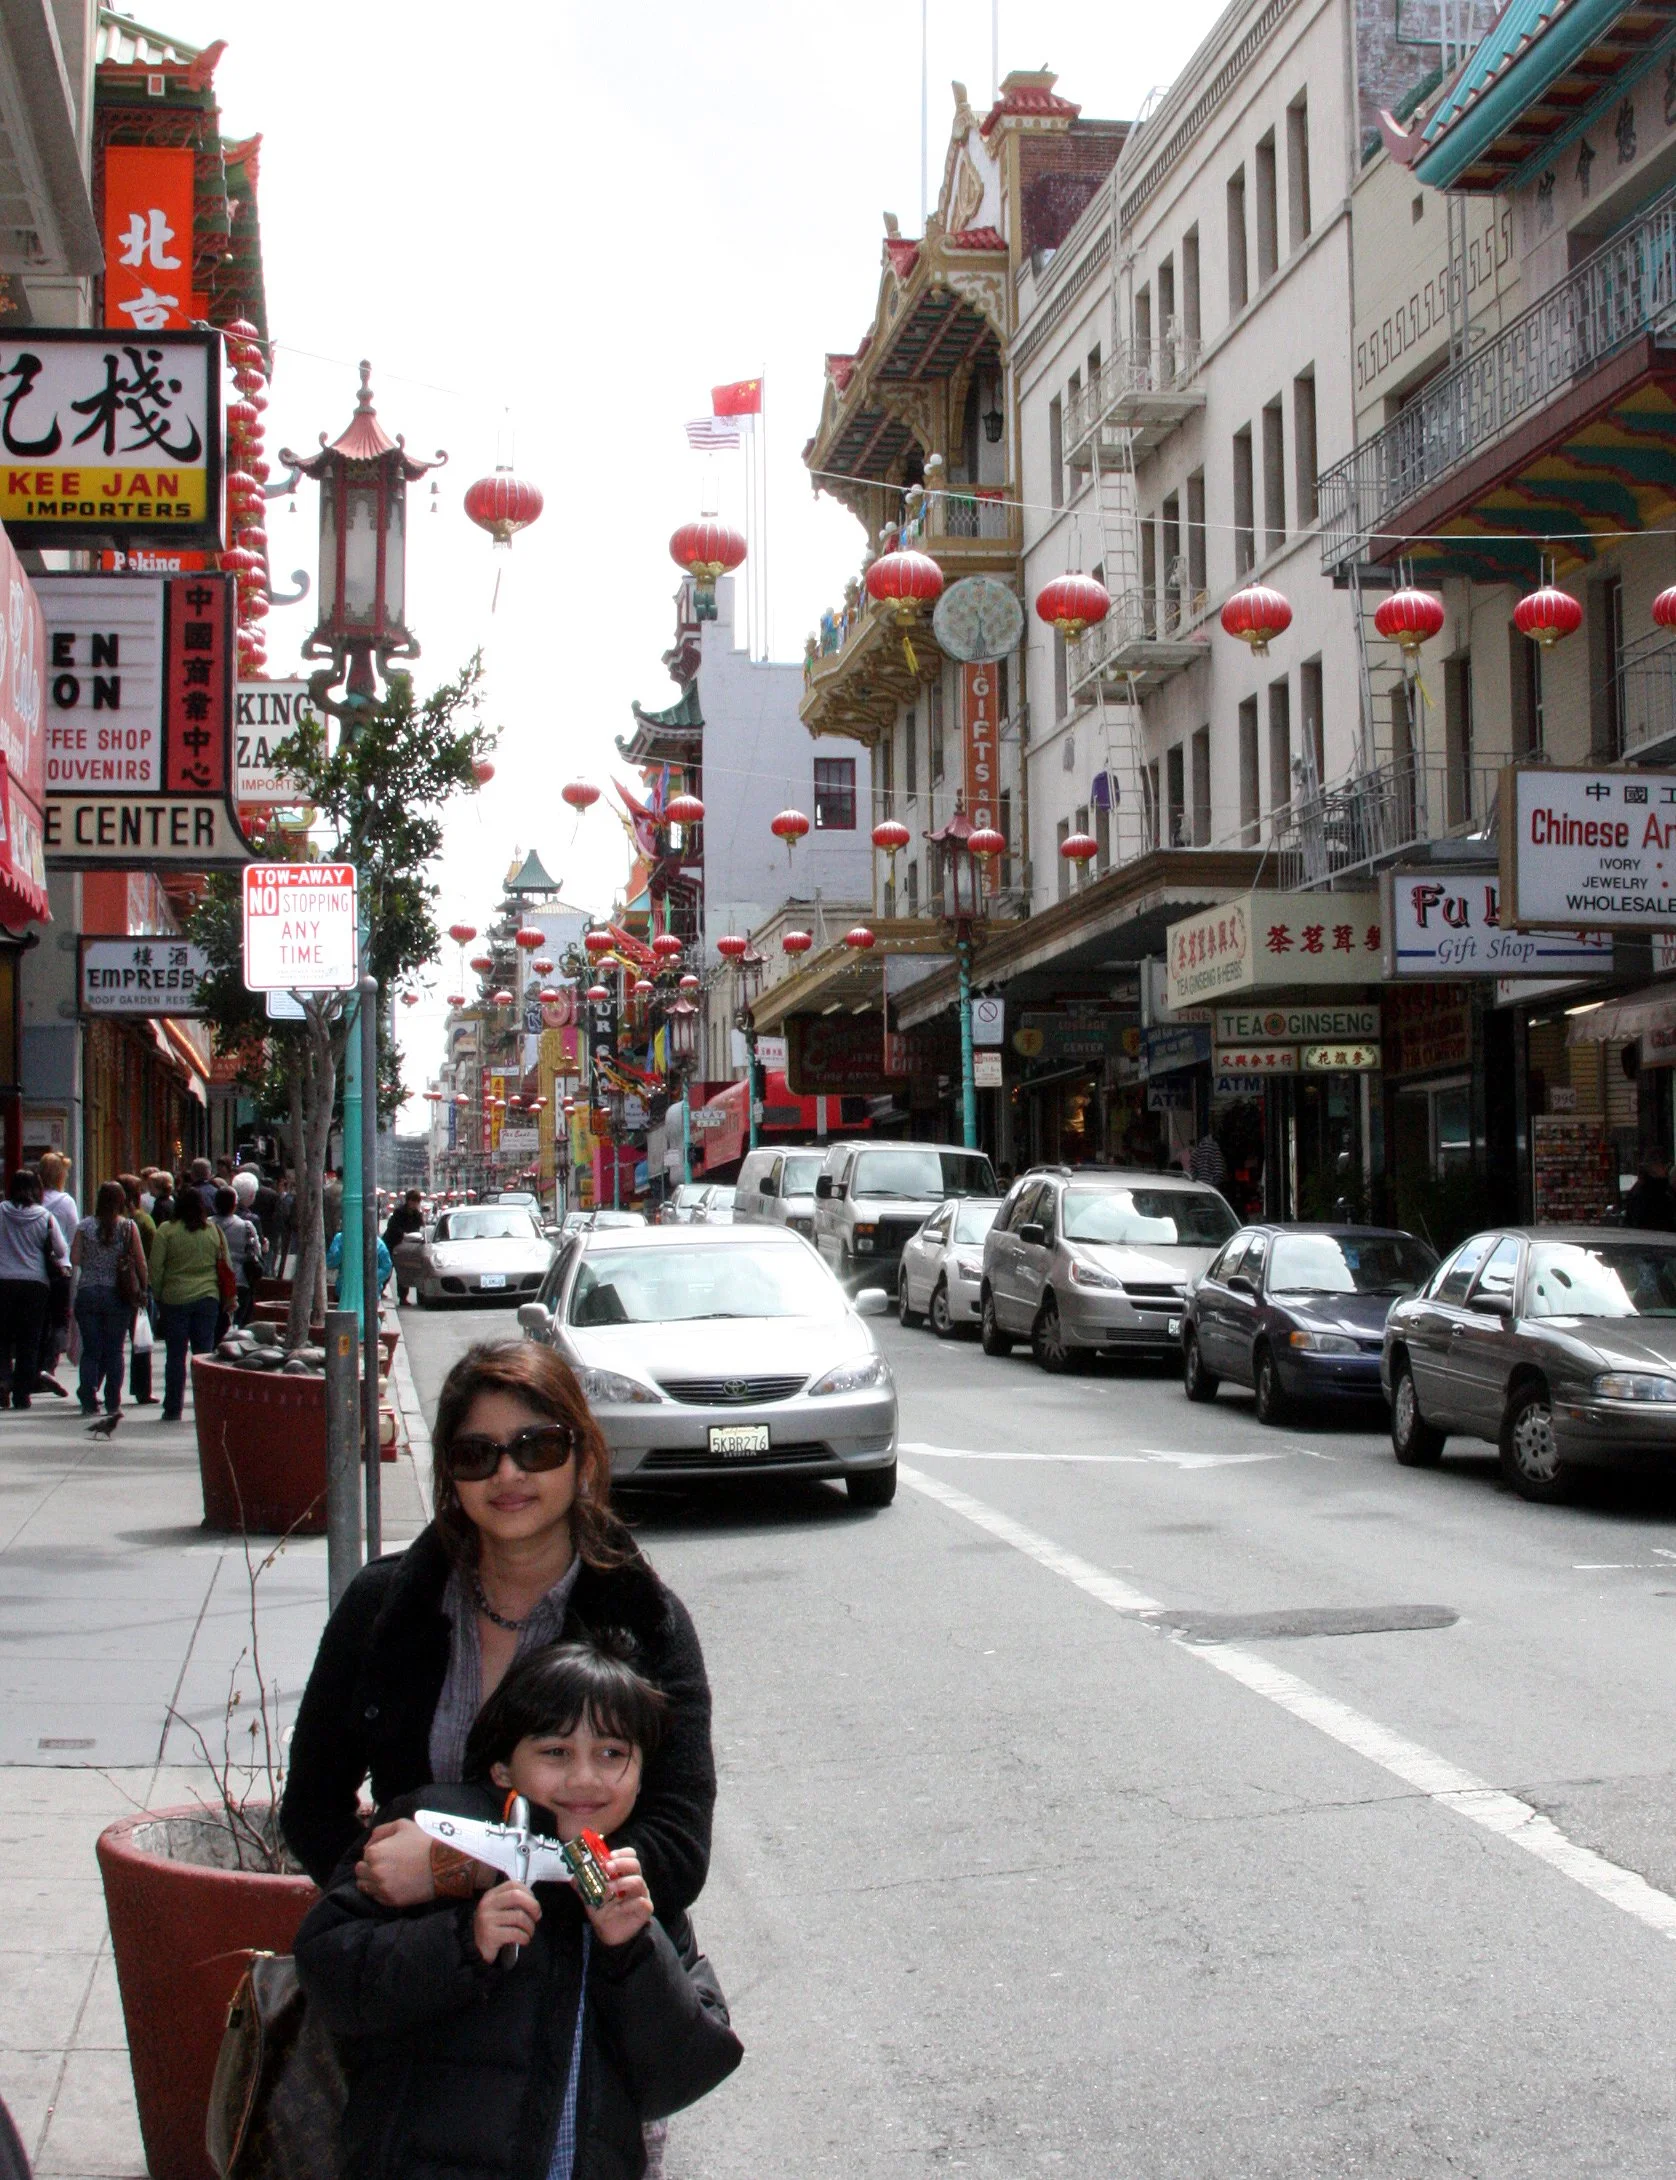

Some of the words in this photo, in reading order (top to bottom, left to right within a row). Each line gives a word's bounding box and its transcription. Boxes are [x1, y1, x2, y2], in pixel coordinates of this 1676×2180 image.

[8, 472, 80, 496] KEE
[102, 472, 180, 497] JAN
[26, 502, 192, 518] IMPORTERS
[237, 693, 313, 726] KING
[97, 728, 152, 750] SHOP
[972, 677, 992, 782] GIFTS
[47, 759, 151, 781] OUVENIRS
[242, 779, 301, 791] IMPORTS
[75, 805, 215, 846] CENTER
[1531, 808, 1629, 848] Chinese
[1600, 859, 1641, 871] IVORY
[255, 869, 345, 885] TOW-AWAY
[1582, 877, 1648, 890] JEWELRY
[249, 886, 278, 915] NO
[283, 893, 349, 913] STOPPING
[1412, 883, 1469, 928] Fu
[1566, 895, 1676, 913] WHOLESALE
[281, 921, 320, 940] ANY
[279, 945, 324, 964] TIME
[1438, 936, 1477, 964] Gift
[1487, 936, 1535, 963] Shop
[87, 968, 195, 990] EMPRESS
[1176, 977, 1189, 996] TEA
[1189, 969, 1217, 995] GINSENG
[1222, 960, 1243, 982] HERBS
[89, 995, 116, 1005] ROOF
[120, 995, 160, 1005] GARDEN
[1223, 1016, 1264, 1036] TEA
[1288, 1013, 1373, 1034] GINSENG
[1217, 1077, 1261, 1091] ATM
[1152, 1093, 1188, 1107] ATM
[712, 1435, 767, 1453] 5KBR276
